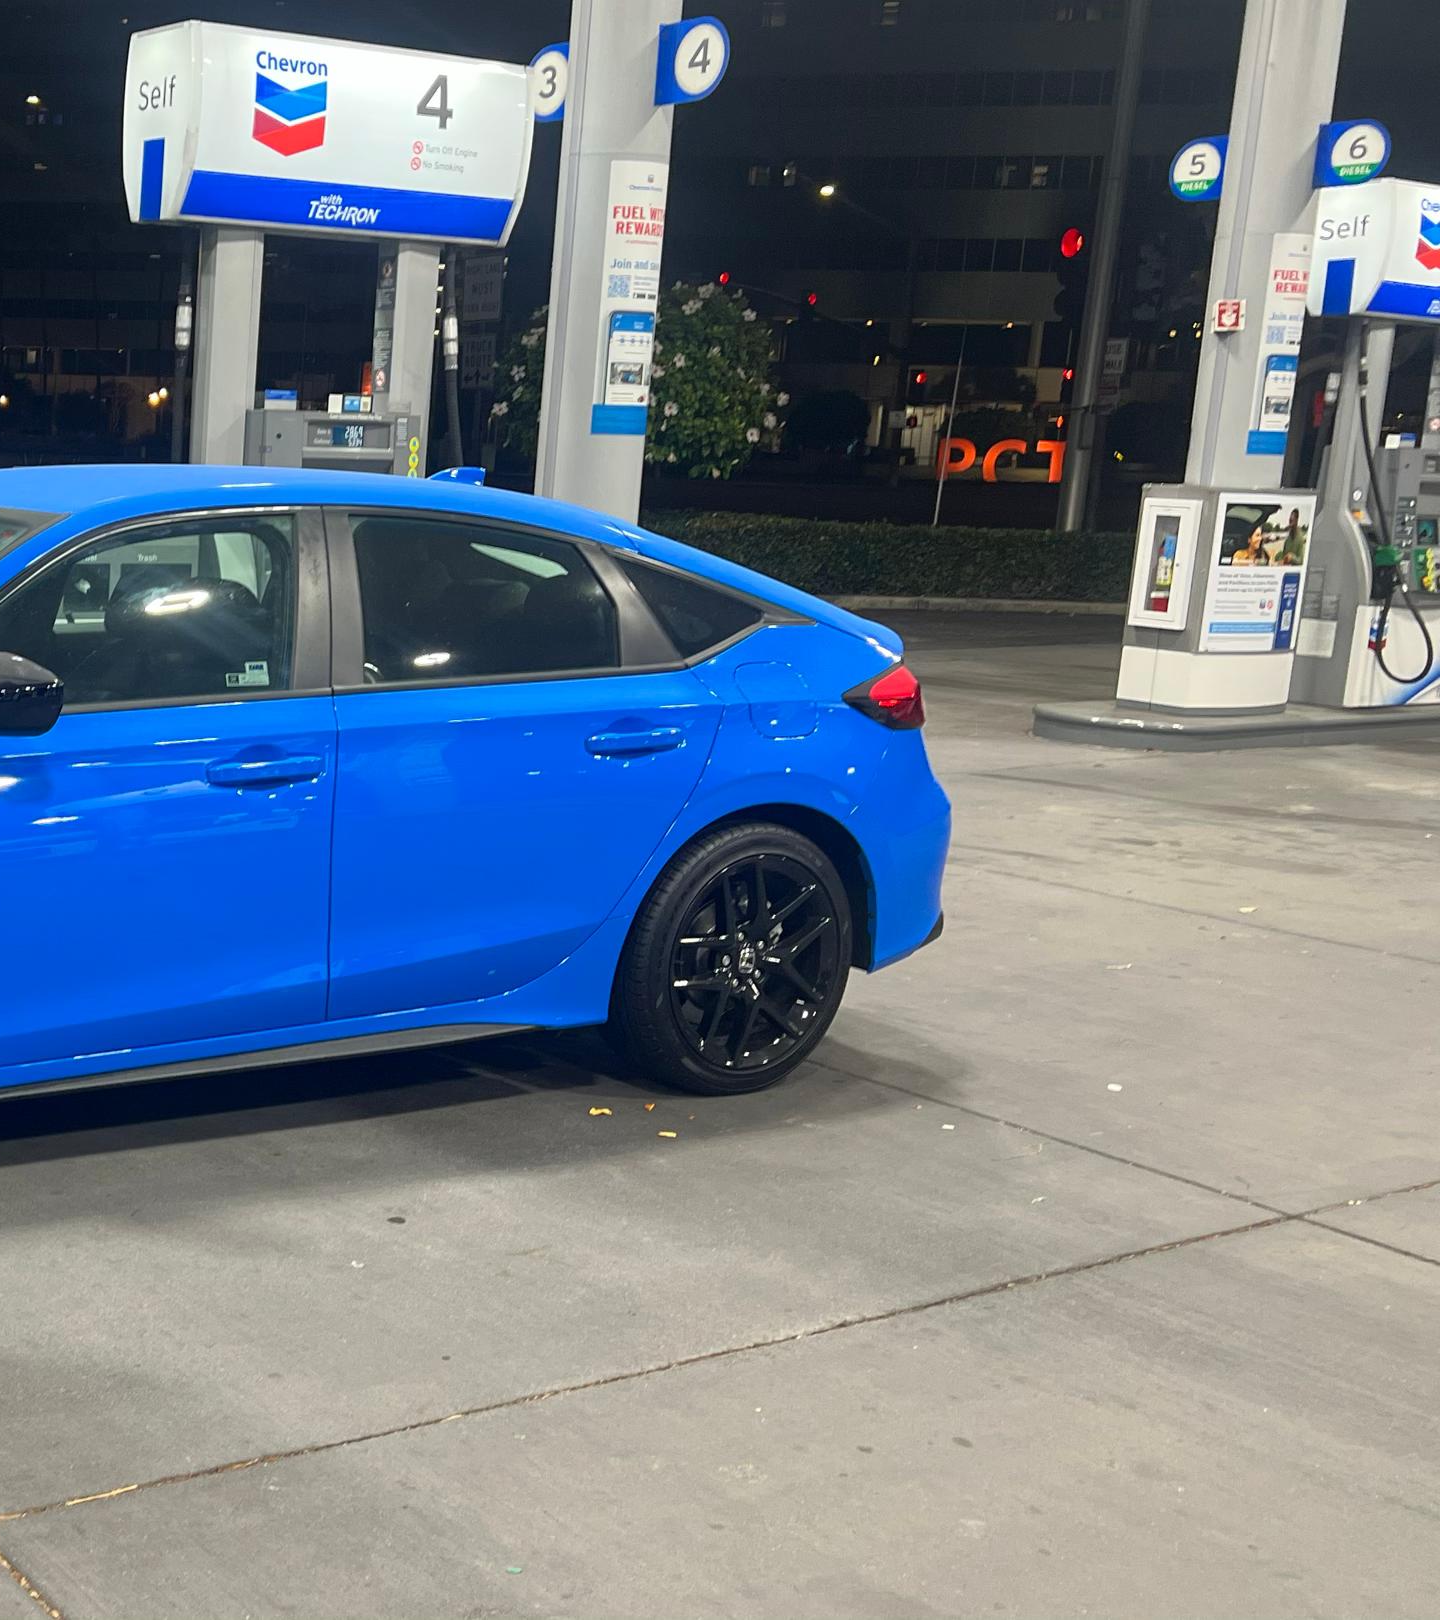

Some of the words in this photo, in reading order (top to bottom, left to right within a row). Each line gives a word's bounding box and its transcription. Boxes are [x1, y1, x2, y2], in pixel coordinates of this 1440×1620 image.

[256, 50, 328, 77] Chevron
[688, 38, 711, 73] 4
[138, 75, 176, 111] Self
[539, 65, 557, 99] 3
[416, 74, 453, 129] 4
[1349, 135, 1368, 159] 6
[1189, 153, 1206, 176] 5
[1339, 165, 1371, 177] DIESEL
[1180, 181, 1209, 193] DIESEL
[320, 193, 343, 205] with
[308, 201, 381, 226] TECHRON
[613, 205, 646, 219] FUEL
[1320, 215, 1370, 241] Self
[610, 259, 632, 269] Join
[1273, 270, 1300, 280] FUEL
[138, 553, 158, 562] Trash
